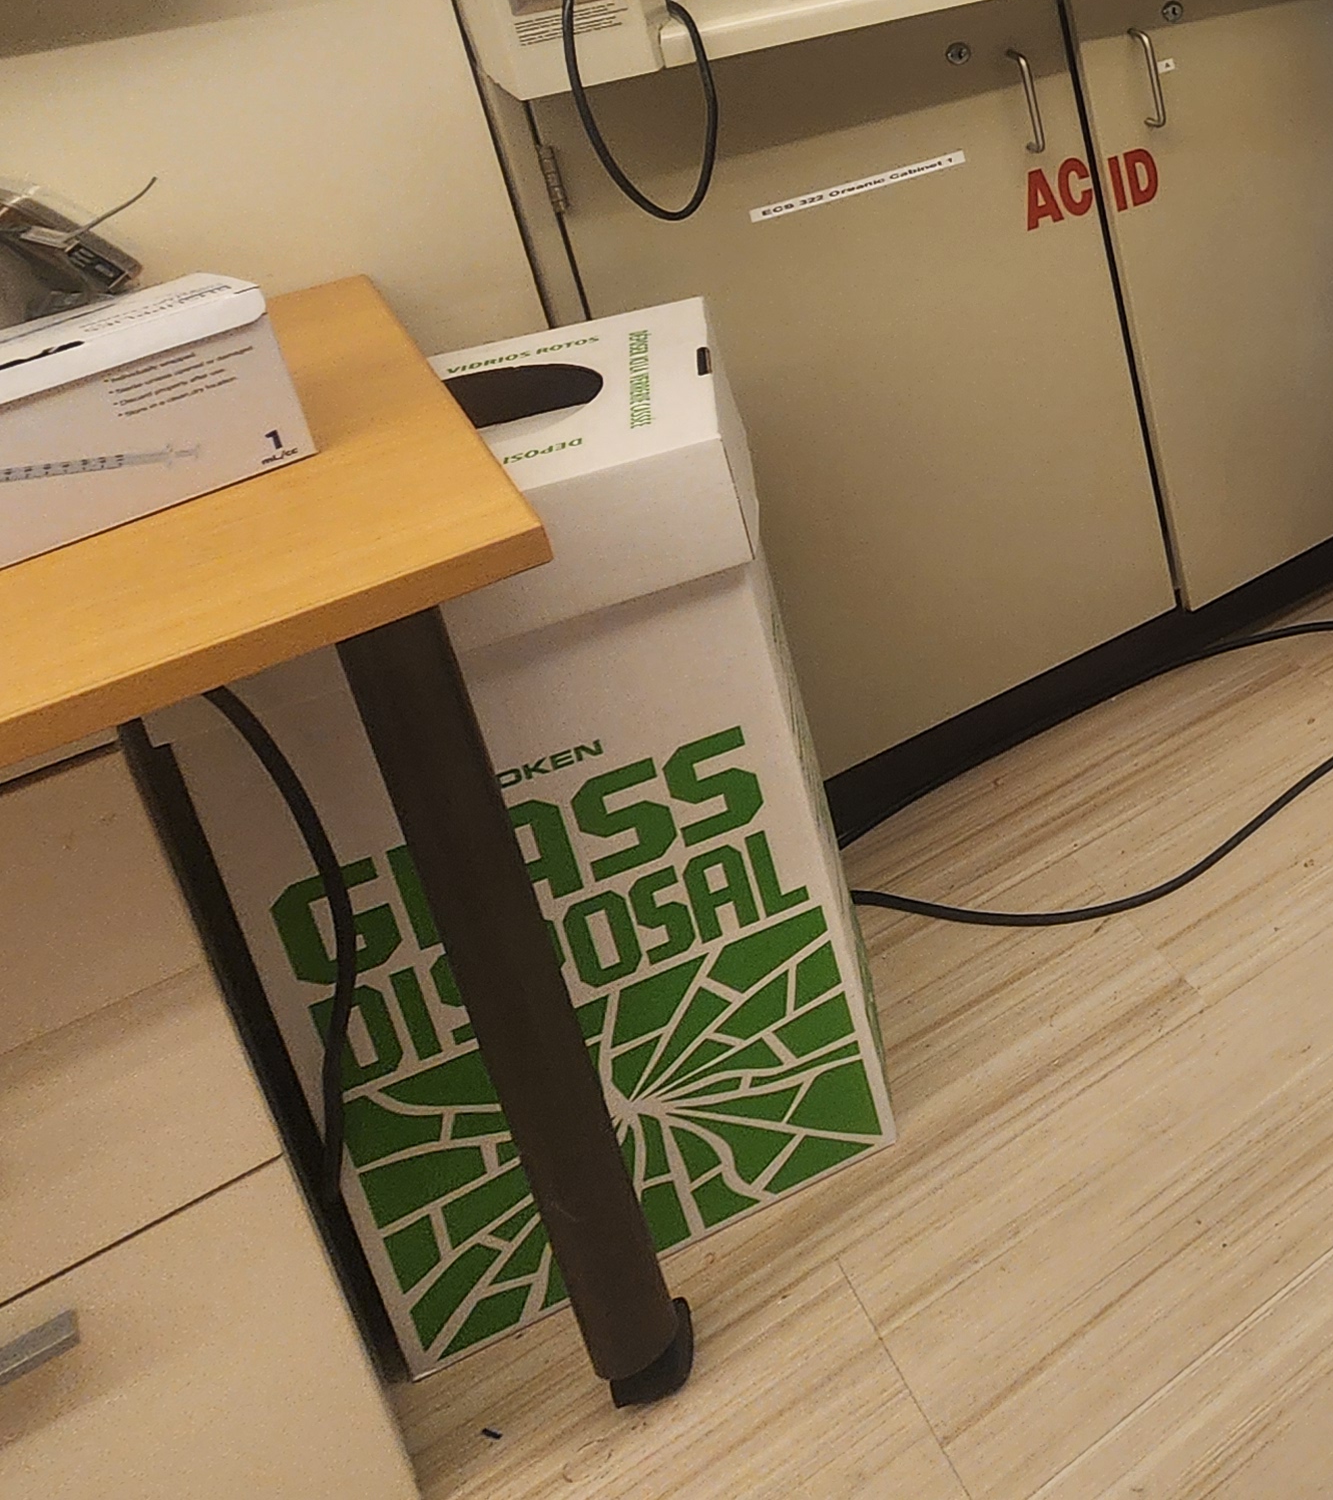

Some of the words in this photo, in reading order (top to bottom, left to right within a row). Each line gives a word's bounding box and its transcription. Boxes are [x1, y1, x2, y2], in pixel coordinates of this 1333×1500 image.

[799, 194, 825, 209] 322
[889, 159, 943, 181] Cabinet
[1026, 148, 1160, 231] ACID
[447, 351, 531, 374] VIDRIOS
[536, 335, 600, 355] ROTOS
[261, 447, 298, 465] mL/cc
[265, 429, 283, 450] 1
[495, 738, 604, 788] OKEN
